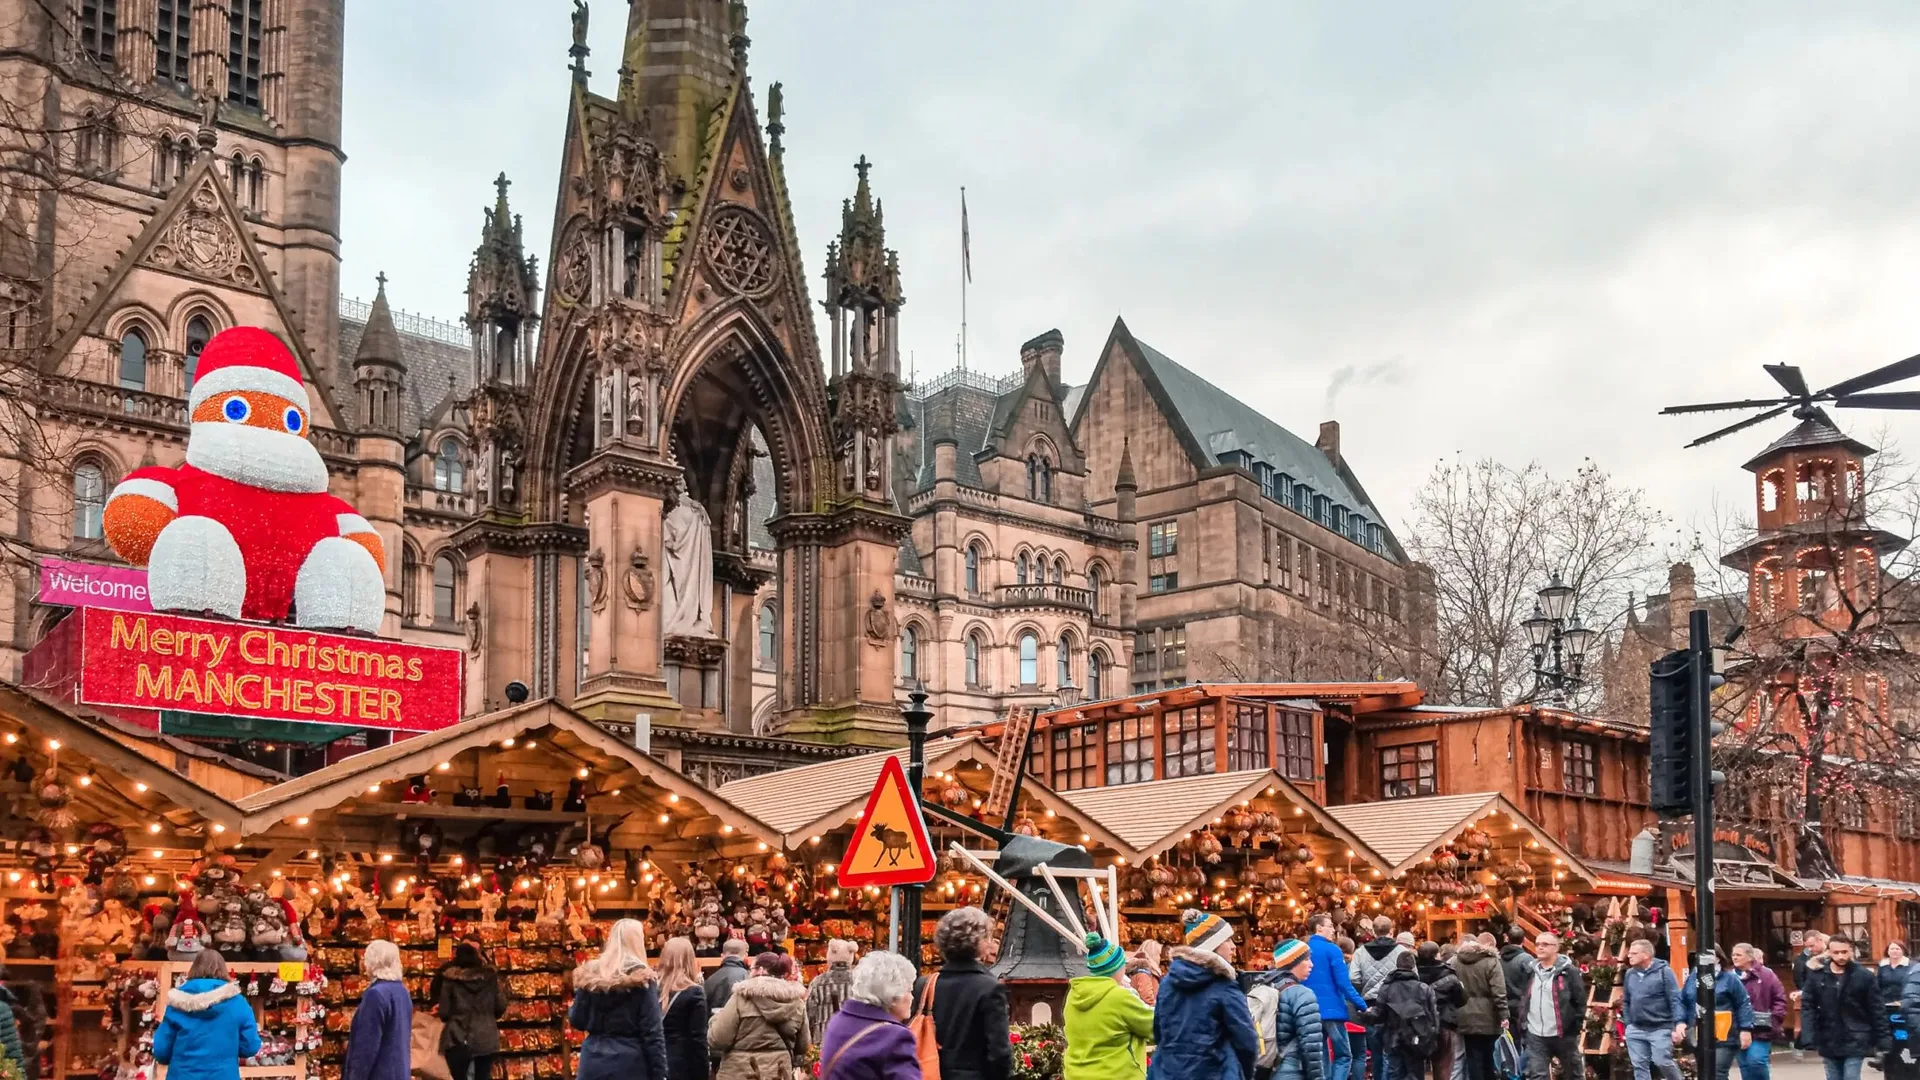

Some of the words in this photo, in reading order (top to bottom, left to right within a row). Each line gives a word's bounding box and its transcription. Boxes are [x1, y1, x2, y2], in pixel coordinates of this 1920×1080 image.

[49, 572, 147, 600] Welcome
[111, 616, 230, 668] Merry
[239, 630, 423, 681] Christmas
[136, 664, 402, 721] MANCHESTER
